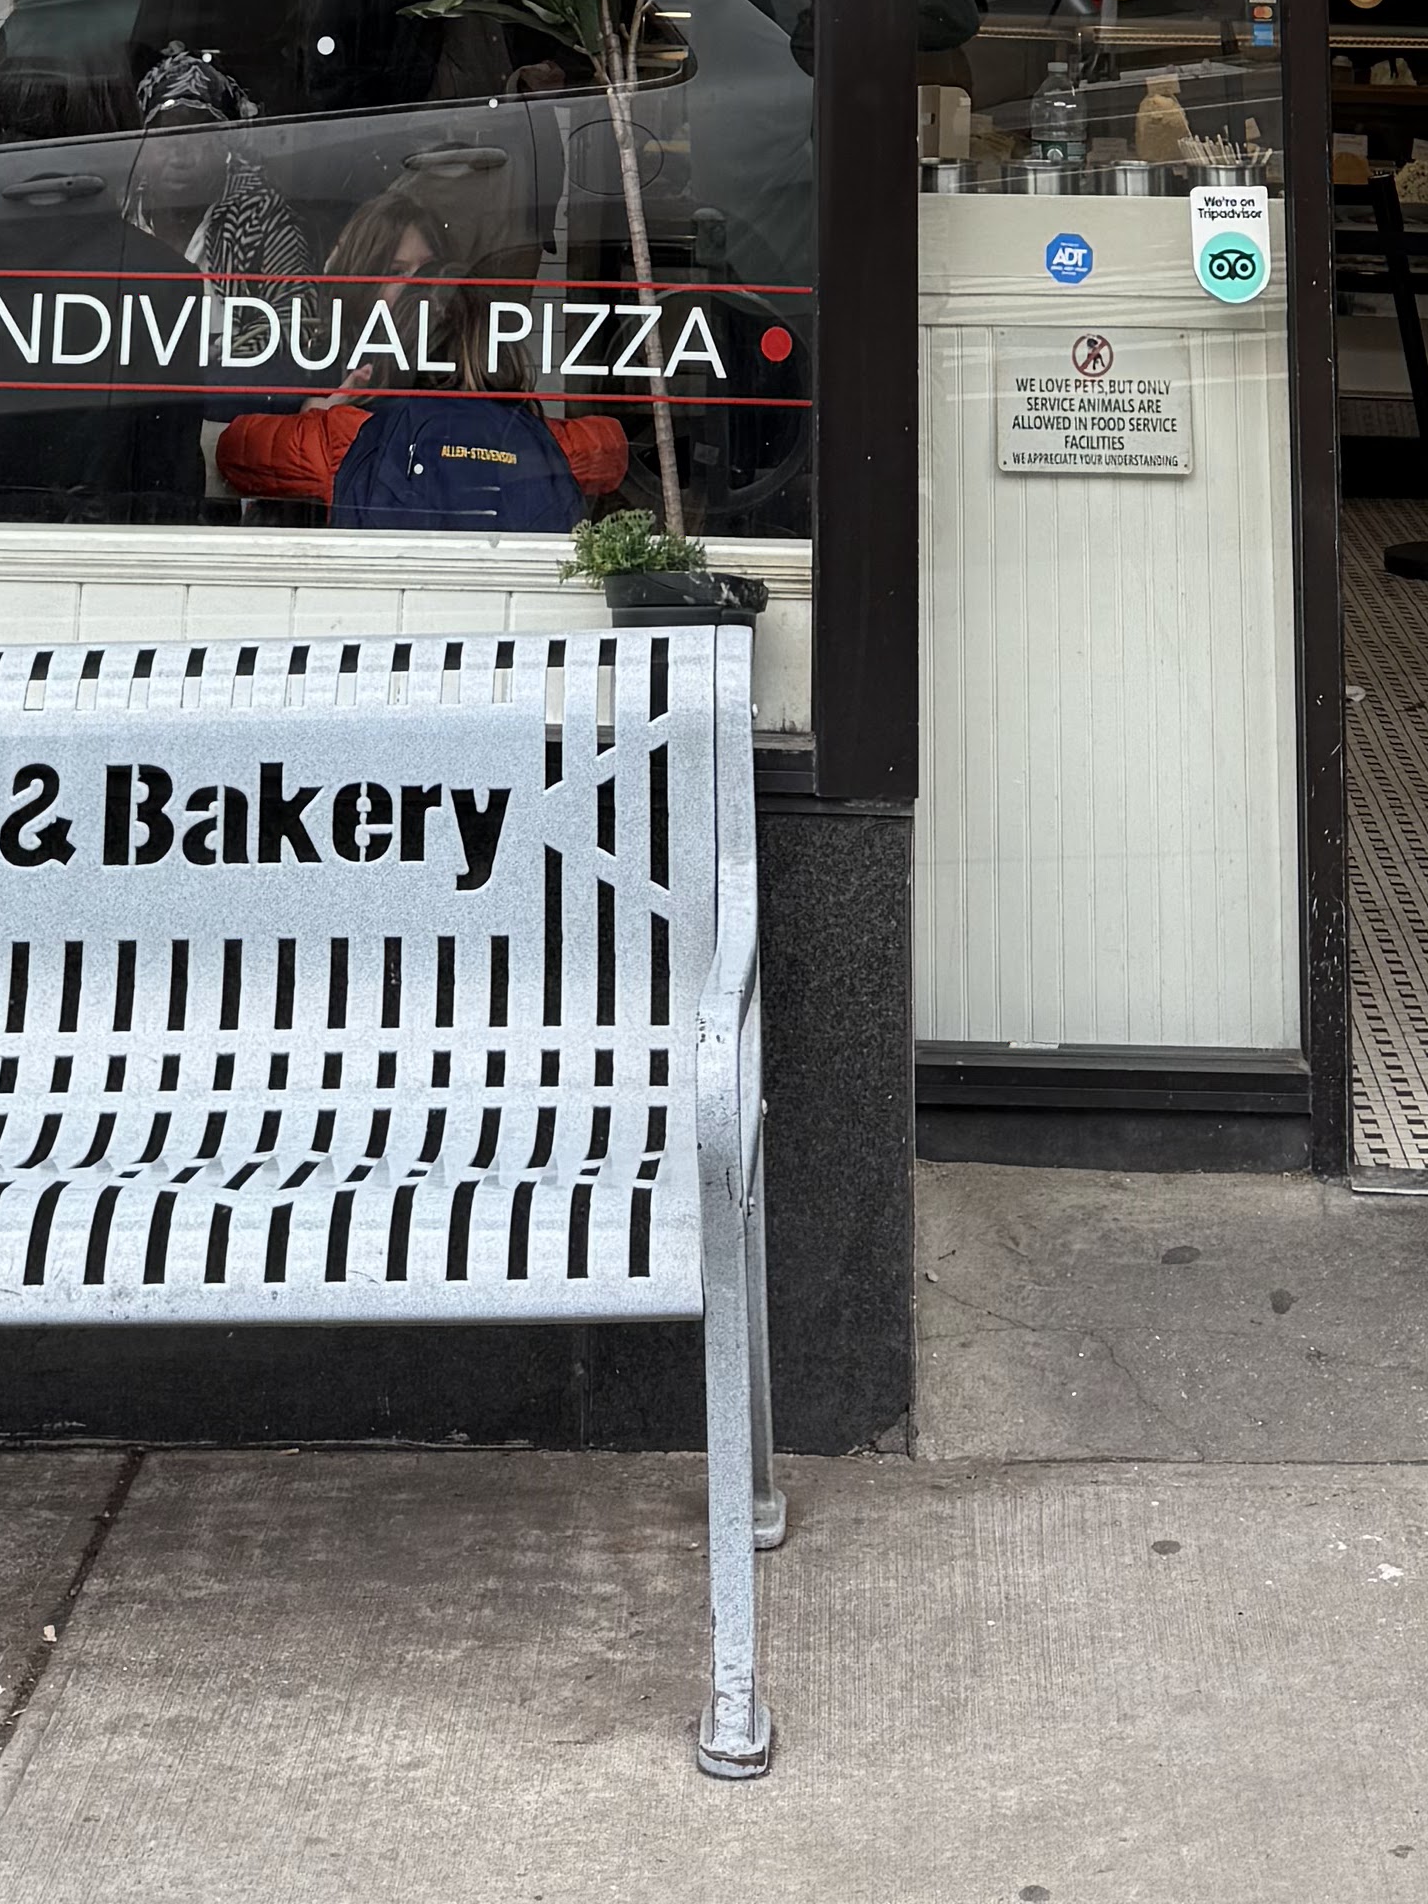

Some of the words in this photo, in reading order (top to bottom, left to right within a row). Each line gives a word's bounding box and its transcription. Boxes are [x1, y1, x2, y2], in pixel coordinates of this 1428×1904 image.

[1203, 196, 1238, 209] We're
[1239, 198, 1256, 208] on
[1197, 207, 1263, 221] Tripadvisor
[1052, 247, 1088, 267] ADT
[486, 300, 728, 379] PIZZA
[1015, 378, 1036, 392] WE
[1039, 378, 1071, 393] LOVE
[1136, 379, 1172, 395] ONLY
[1026, 396, 1076, 412] SERVICE
[1078, 398, 1135, 413] ANIMALS
[1137, 399, 1162, 414] ARE
[1012, 415, 1072, 431] ALLOWED
[1074, 416, 1088, 431] IN
[1091, 416, 1126, 432] FOOD
[1128, 417, 1178, 433] SERVICE
[1064, 434, 1125, 450] FACILITIES
[439, 443, 518, 466] ALLEN-STEVENSON
[1012, 452, 1026, 465] WE
[1027, 452, 1078, 466] APPRECIATE
[1079, 453, 1103, 466] YOUR
[1104, 454, 1179, 467] UNDERSTANDING
[101, 761, 509, 892] Bakery
